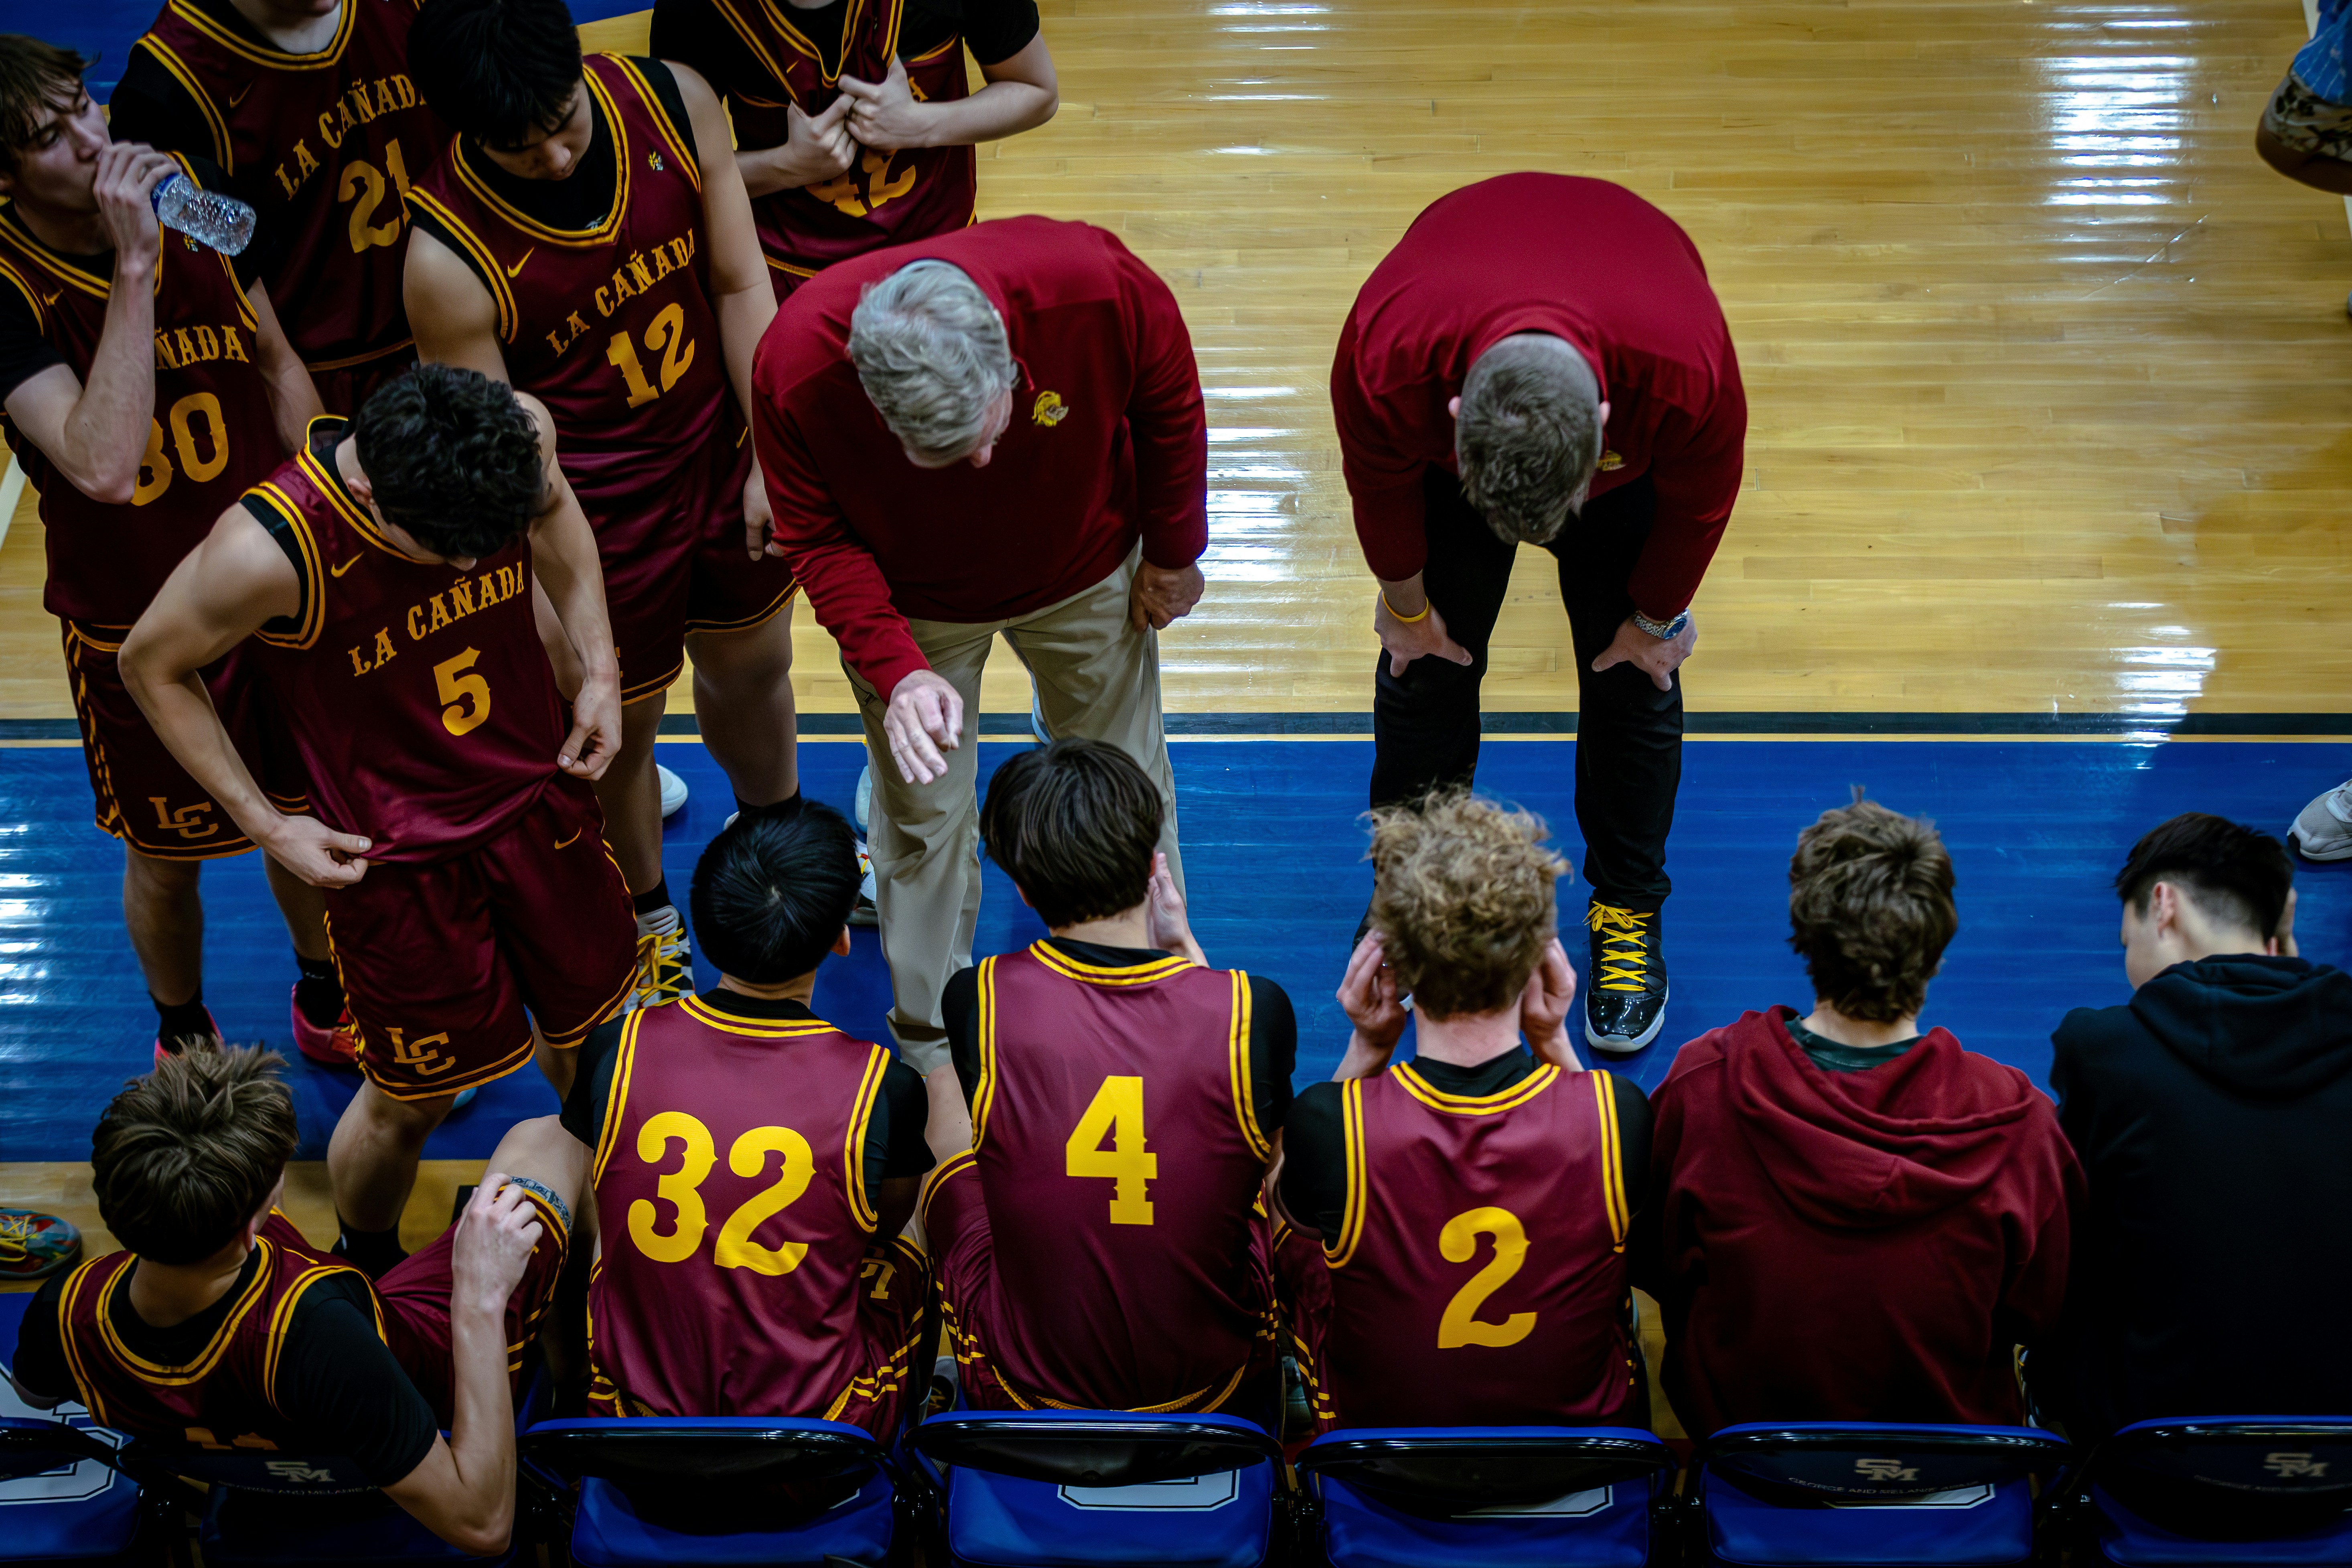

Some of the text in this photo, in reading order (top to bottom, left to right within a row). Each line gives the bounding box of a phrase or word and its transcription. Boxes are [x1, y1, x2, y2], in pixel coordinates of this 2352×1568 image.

[275, 73, 428, 201] LA CAÑAD
[154, 324, 249, 370] ÑADA
[545, 228, 695, 358] LA CAÑADA
[606, 302, 695, 409] 12
[348, 561, 525, 677] LA CAÑADA
[433, 646, 491, 736] 5
[148, 797, 219, 839] LC
[385, 1027, 456, 1075] LC
[628, 1111, 816, 1276] 32
[1065, 1075, 1157, 1226] 4
[1437, 1206, 1538, 1349] 2
